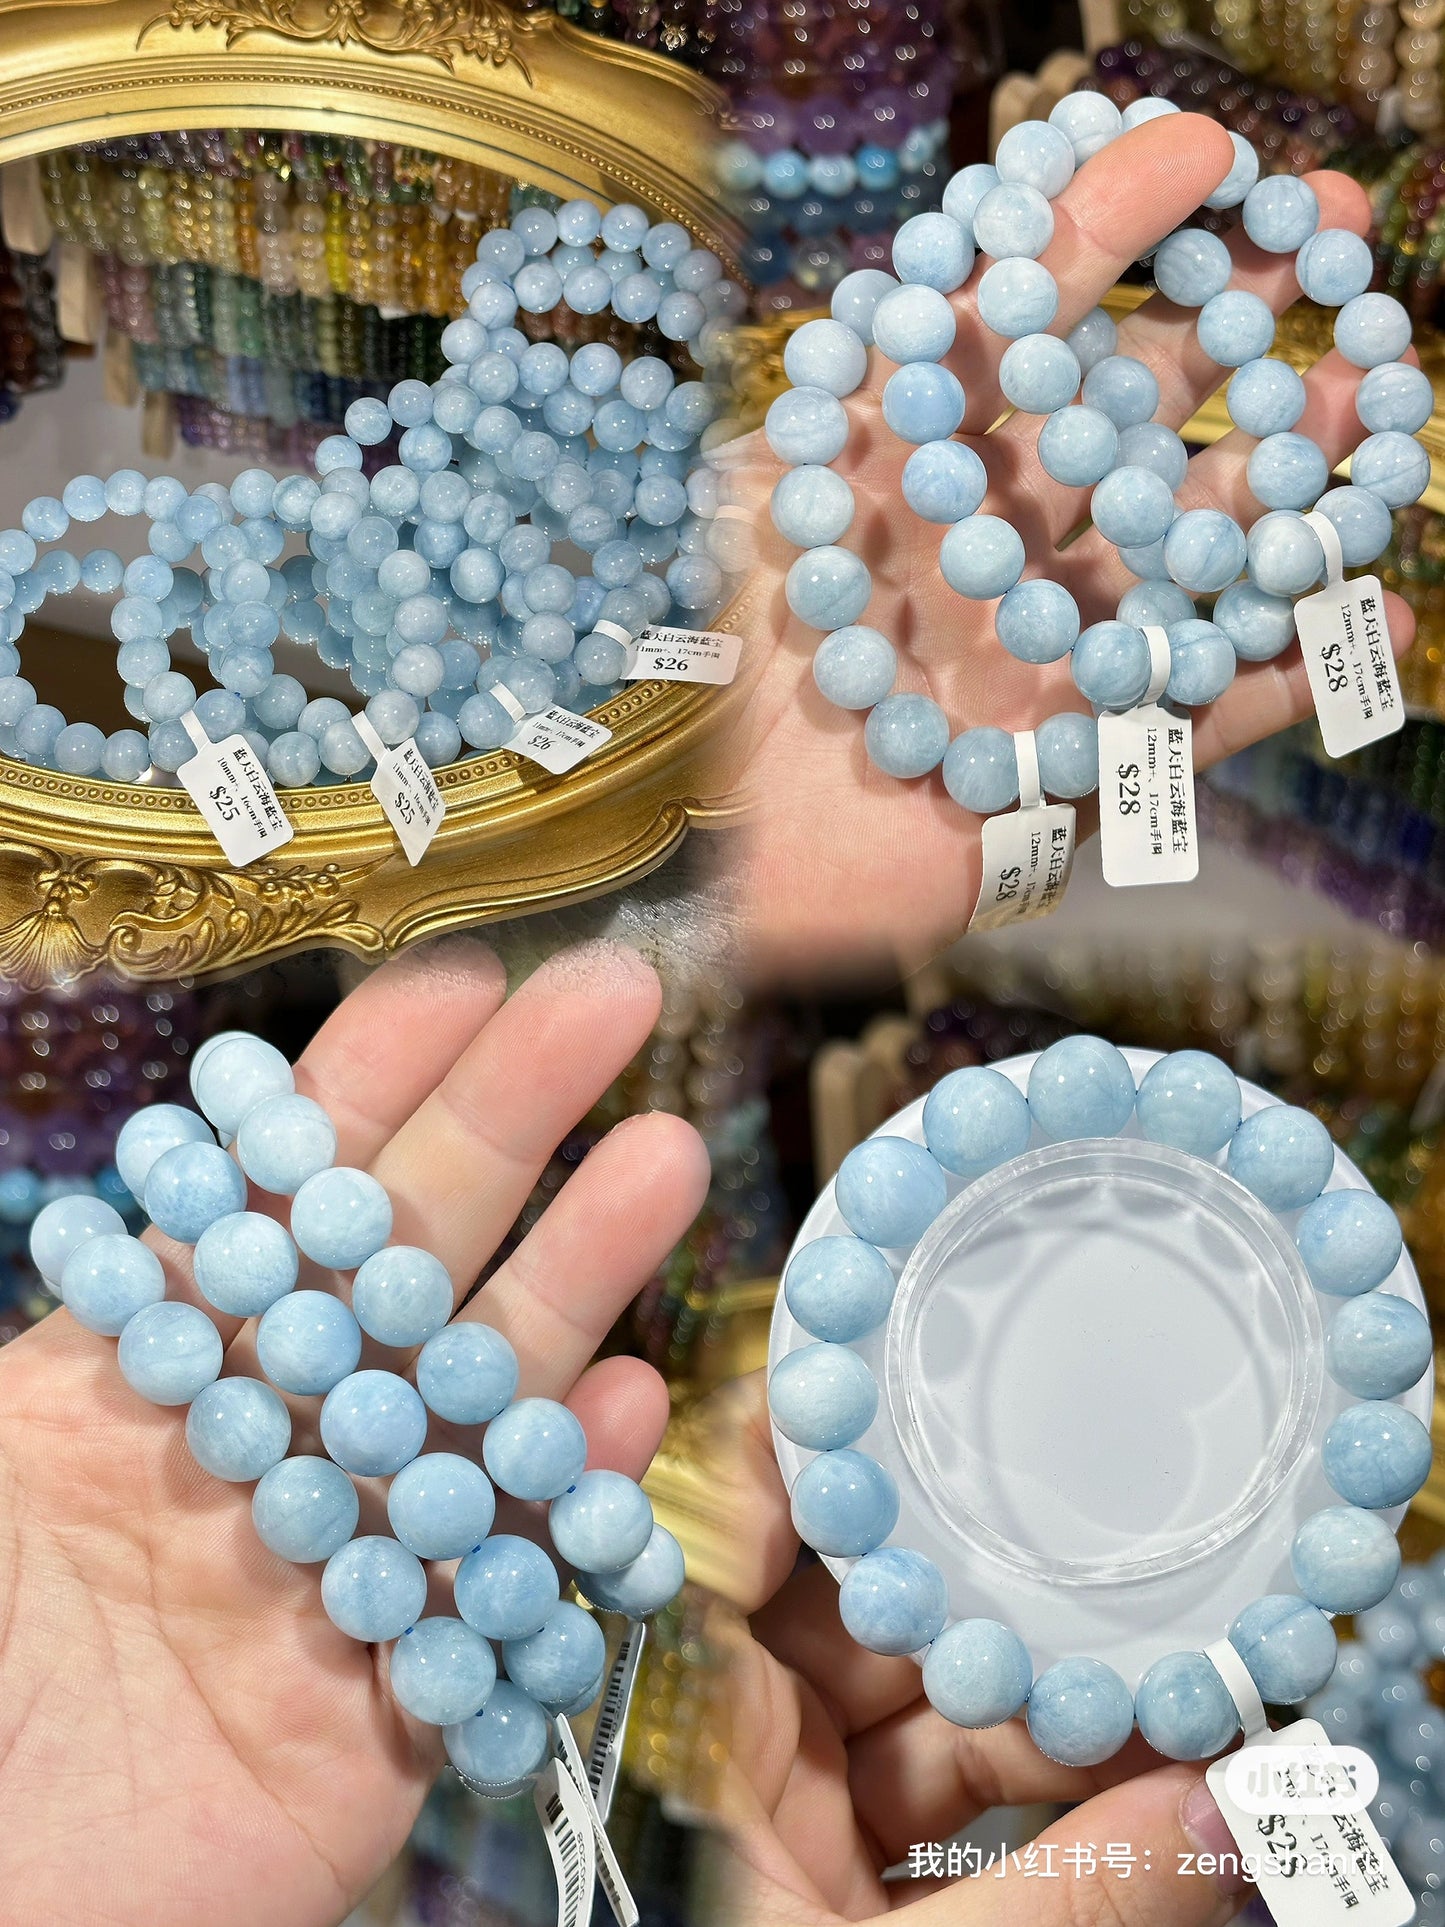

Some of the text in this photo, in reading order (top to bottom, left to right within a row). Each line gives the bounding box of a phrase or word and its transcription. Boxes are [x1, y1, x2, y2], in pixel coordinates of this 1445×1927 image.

[652, 657, 690, 671] $26
[1319, 642, 1349, 693] $28
[527, 735, 557, 750] $26
[209, 785, 241, 821] $25
[1115, 763, 1142, 816] $28
[394, 792, 416, 825] $25
[995, 866, 1022, 901] $28
